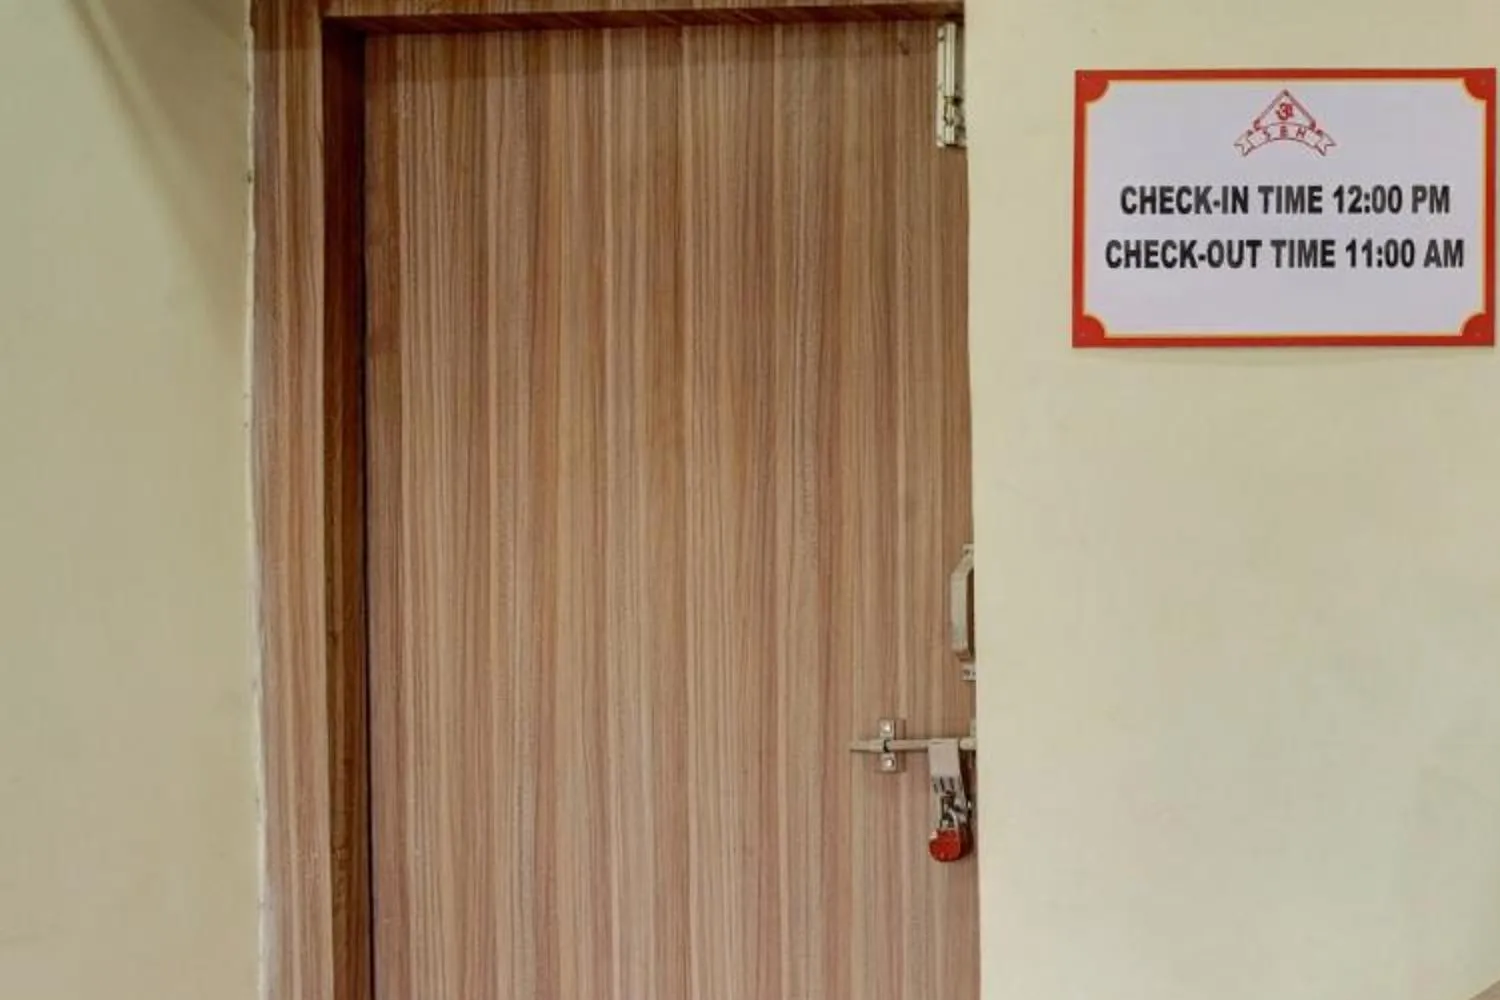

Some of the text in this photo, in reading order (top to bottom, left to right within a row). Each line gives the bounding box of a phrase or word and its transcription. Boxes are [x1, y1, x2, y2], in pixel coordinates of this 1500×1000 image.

[1120, 184, 1451, 215] CHECK-IN TIME 12:00 PM
[1105, 238, 1464, 269] CHECK-OUT TIME 11:00 AM
